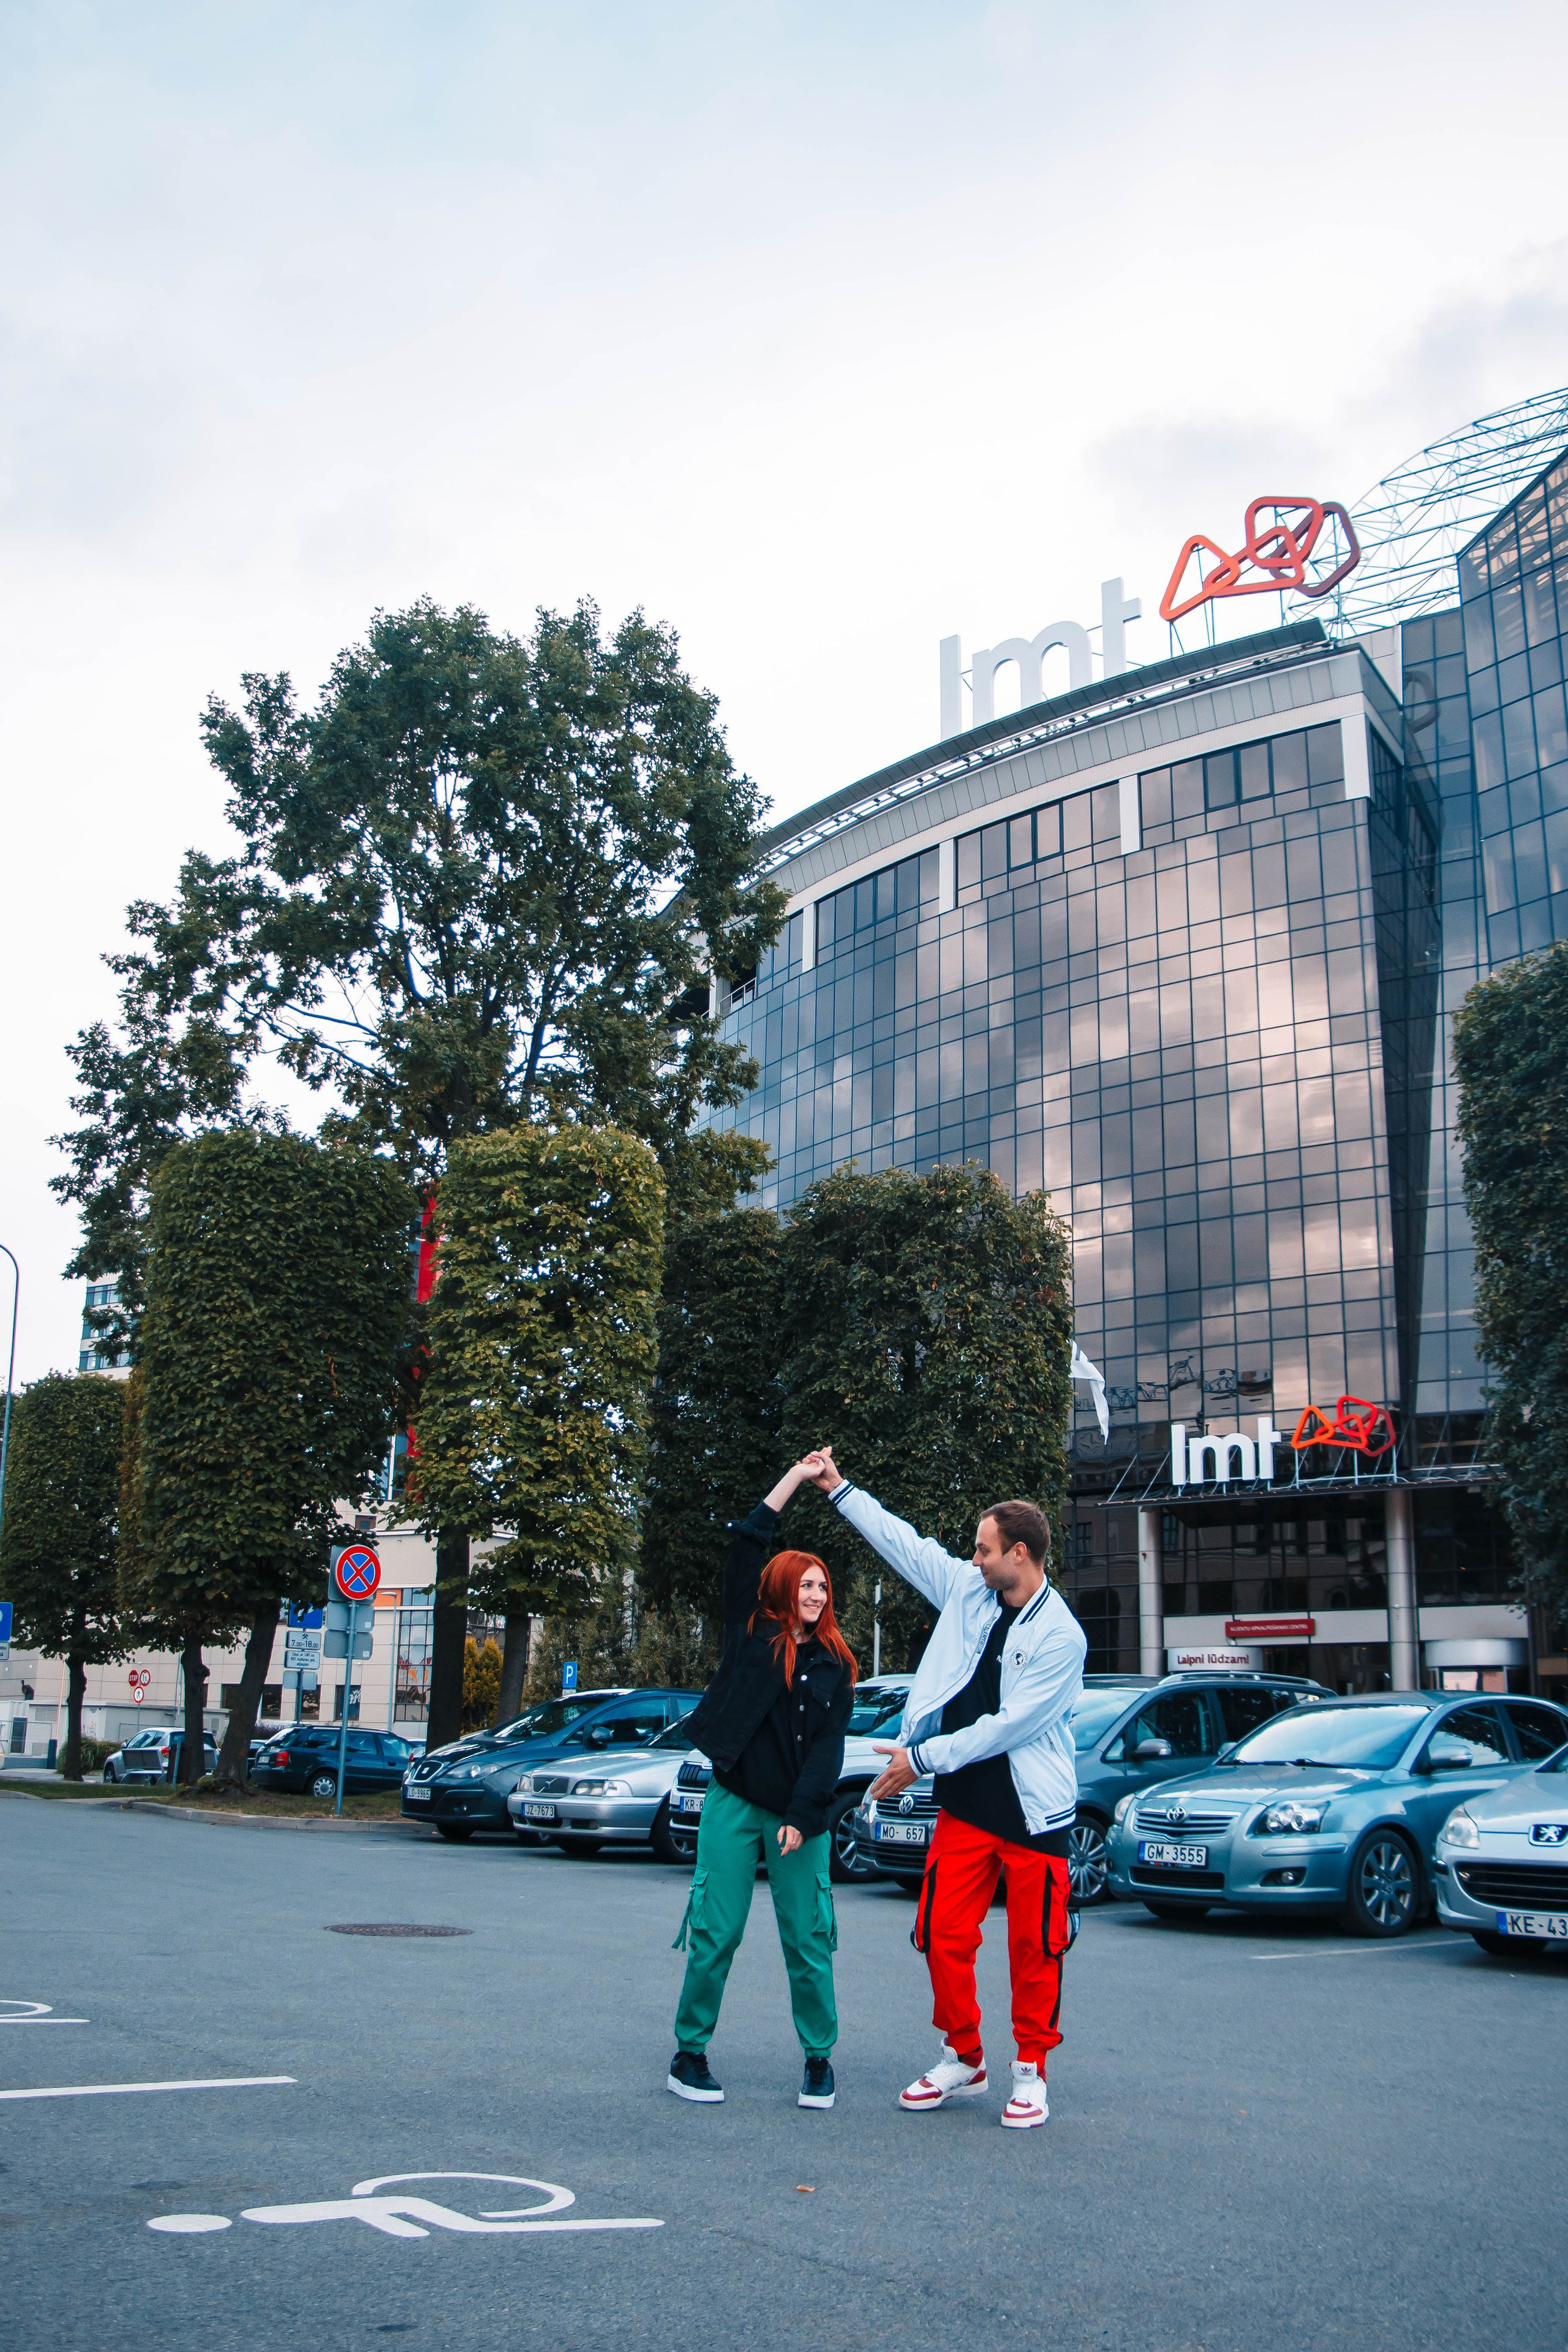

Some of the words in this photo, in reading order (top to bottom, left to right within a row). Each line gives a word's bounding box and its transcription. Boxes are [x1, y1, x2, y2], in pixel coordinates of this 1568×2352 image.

[976, 1631, 987, 1654] EXPEDITION
[1177, 1654, 1205, 1667] Laipni
[566, 1665, 574, 1684] P
[526, 1804, 554, 1816] JZ-7673
[1147, 1844, 1204, 1863] GM-3555
[1510, 1915, 1568, 1937] KE-43
